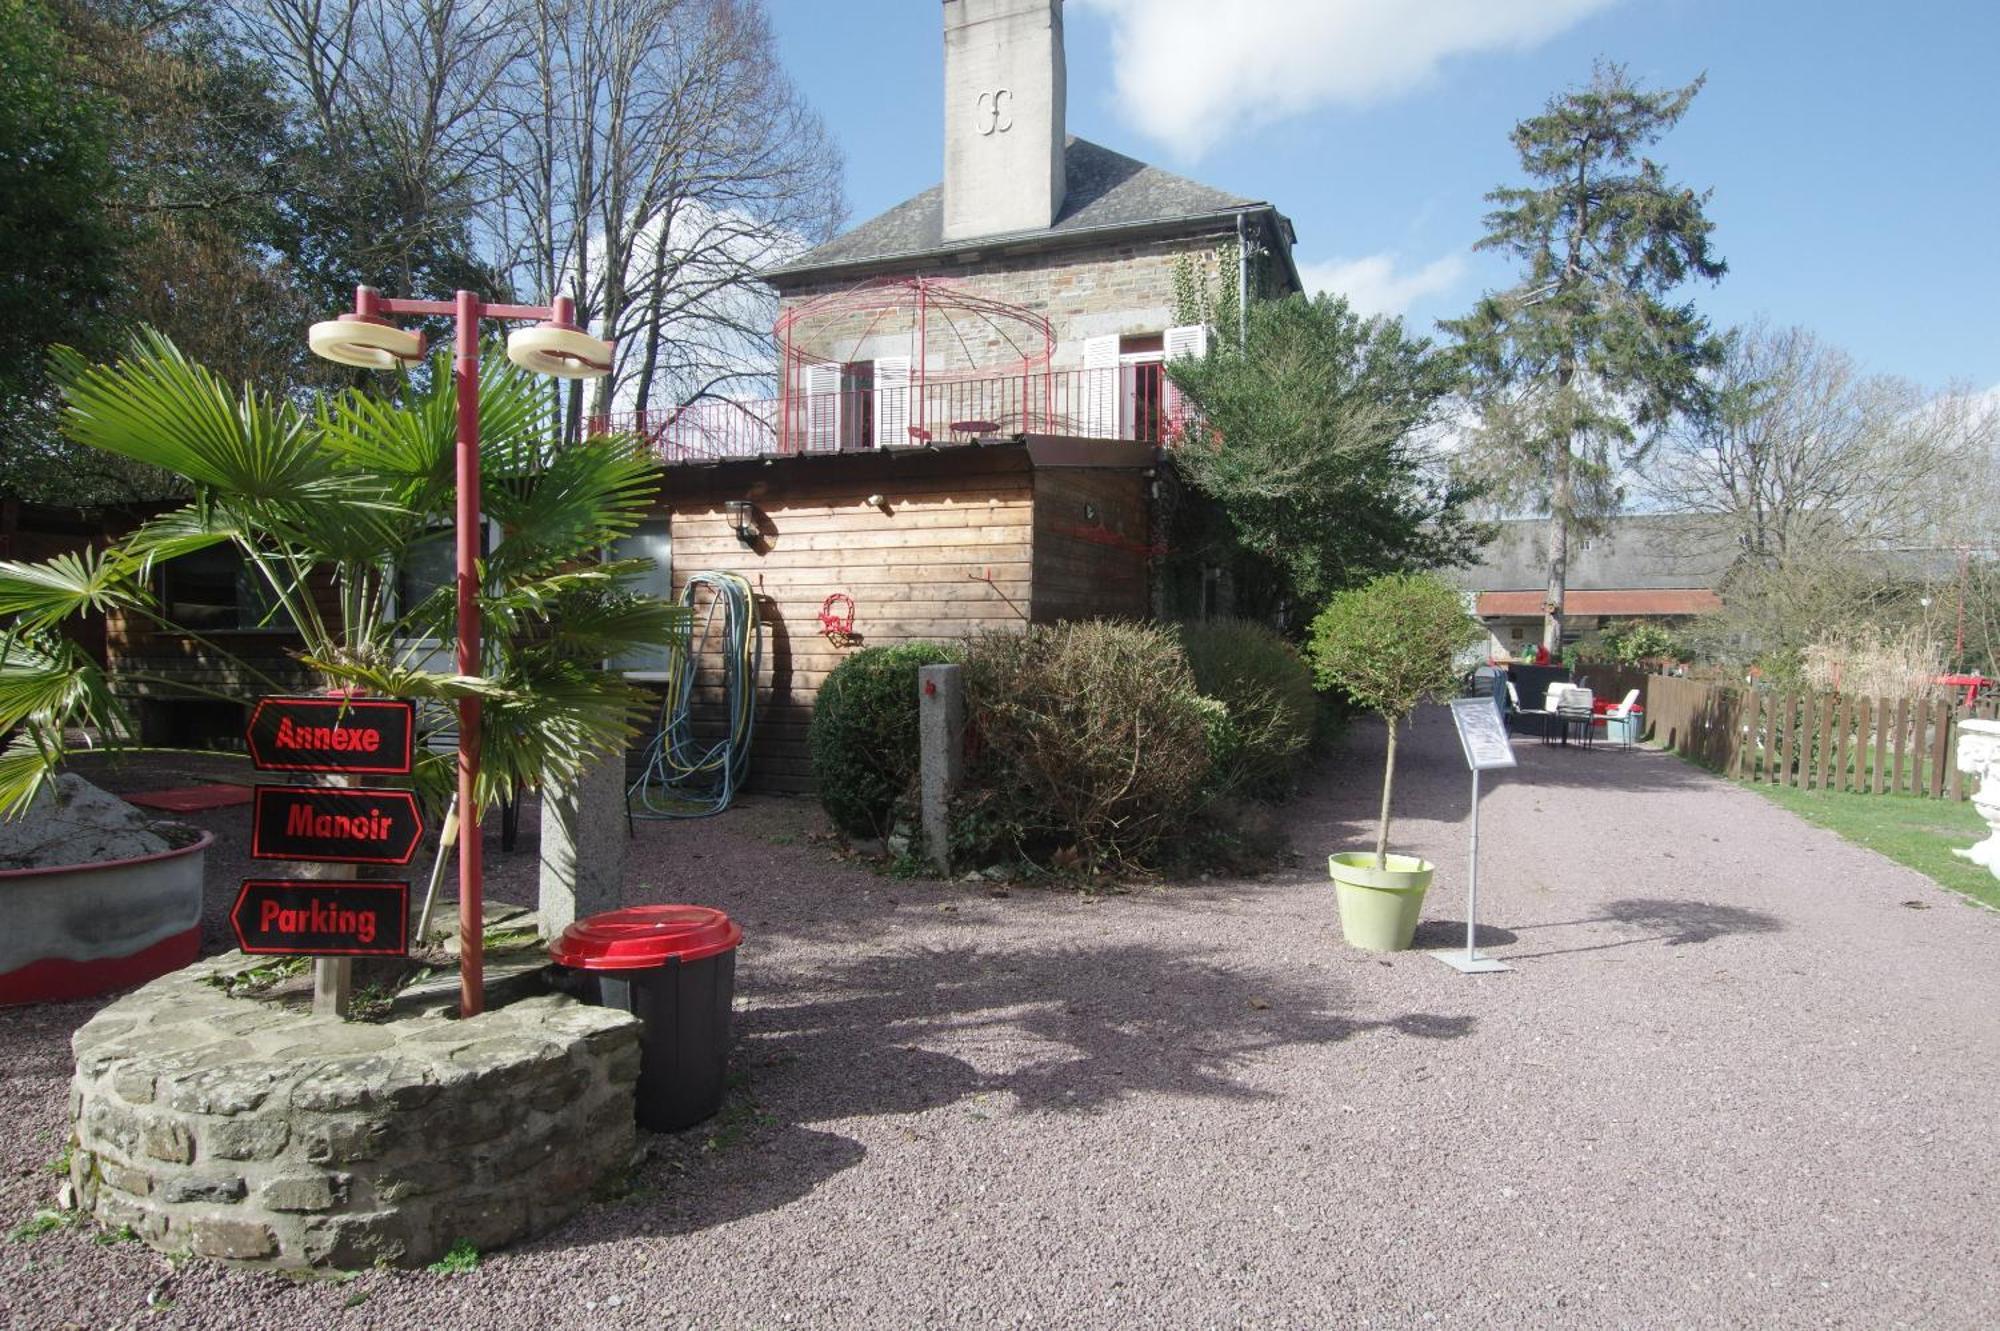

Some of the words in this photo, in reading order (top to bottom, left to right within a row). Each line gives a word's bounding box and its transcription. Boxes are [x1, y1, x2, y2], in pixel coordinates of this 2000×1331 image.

[275, 716, 381, 751] Annexe
[287, 803, 393, 839] Manoir
[260, 899, 377, 943] Parking
